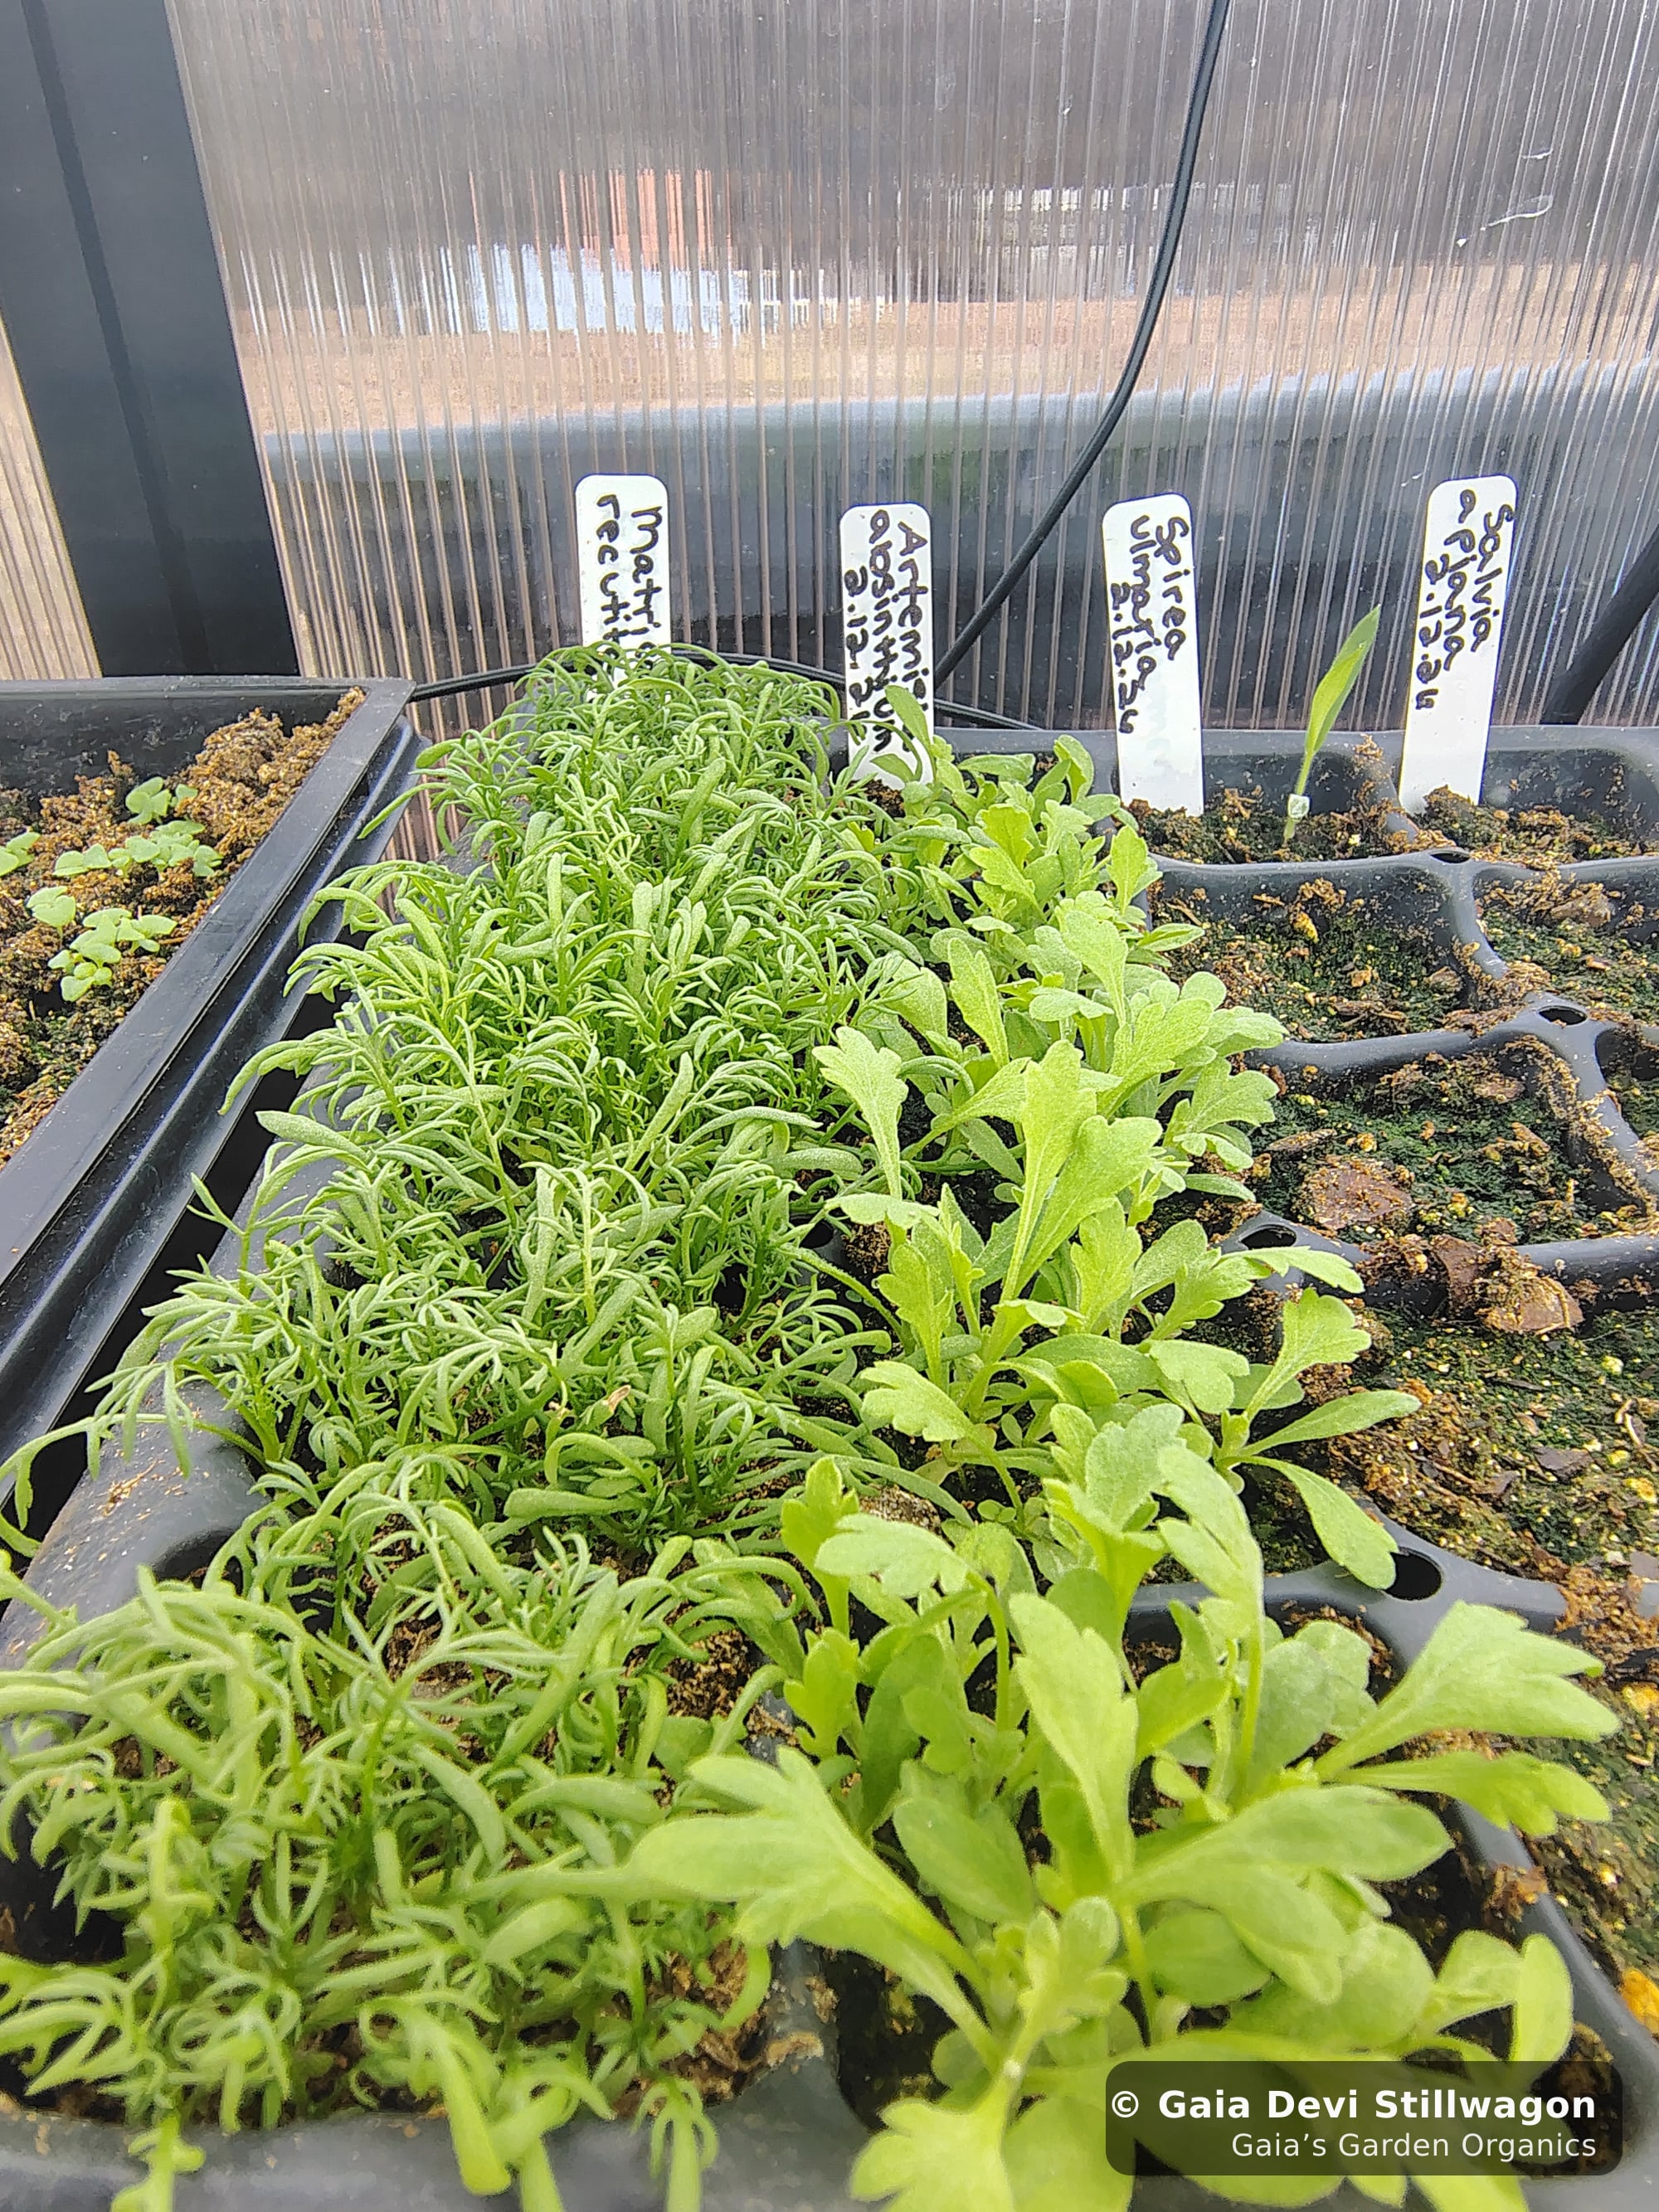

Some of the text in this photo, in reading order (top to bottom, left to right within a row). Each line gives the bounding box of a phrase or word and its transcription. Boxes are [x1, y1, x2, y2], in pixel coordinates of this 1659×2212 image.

[1129, 515, 1161, 691] ulmaria
[1154, 516, 1190, 660] Spirea
[1469, 503, 1515, 653] Salvia
